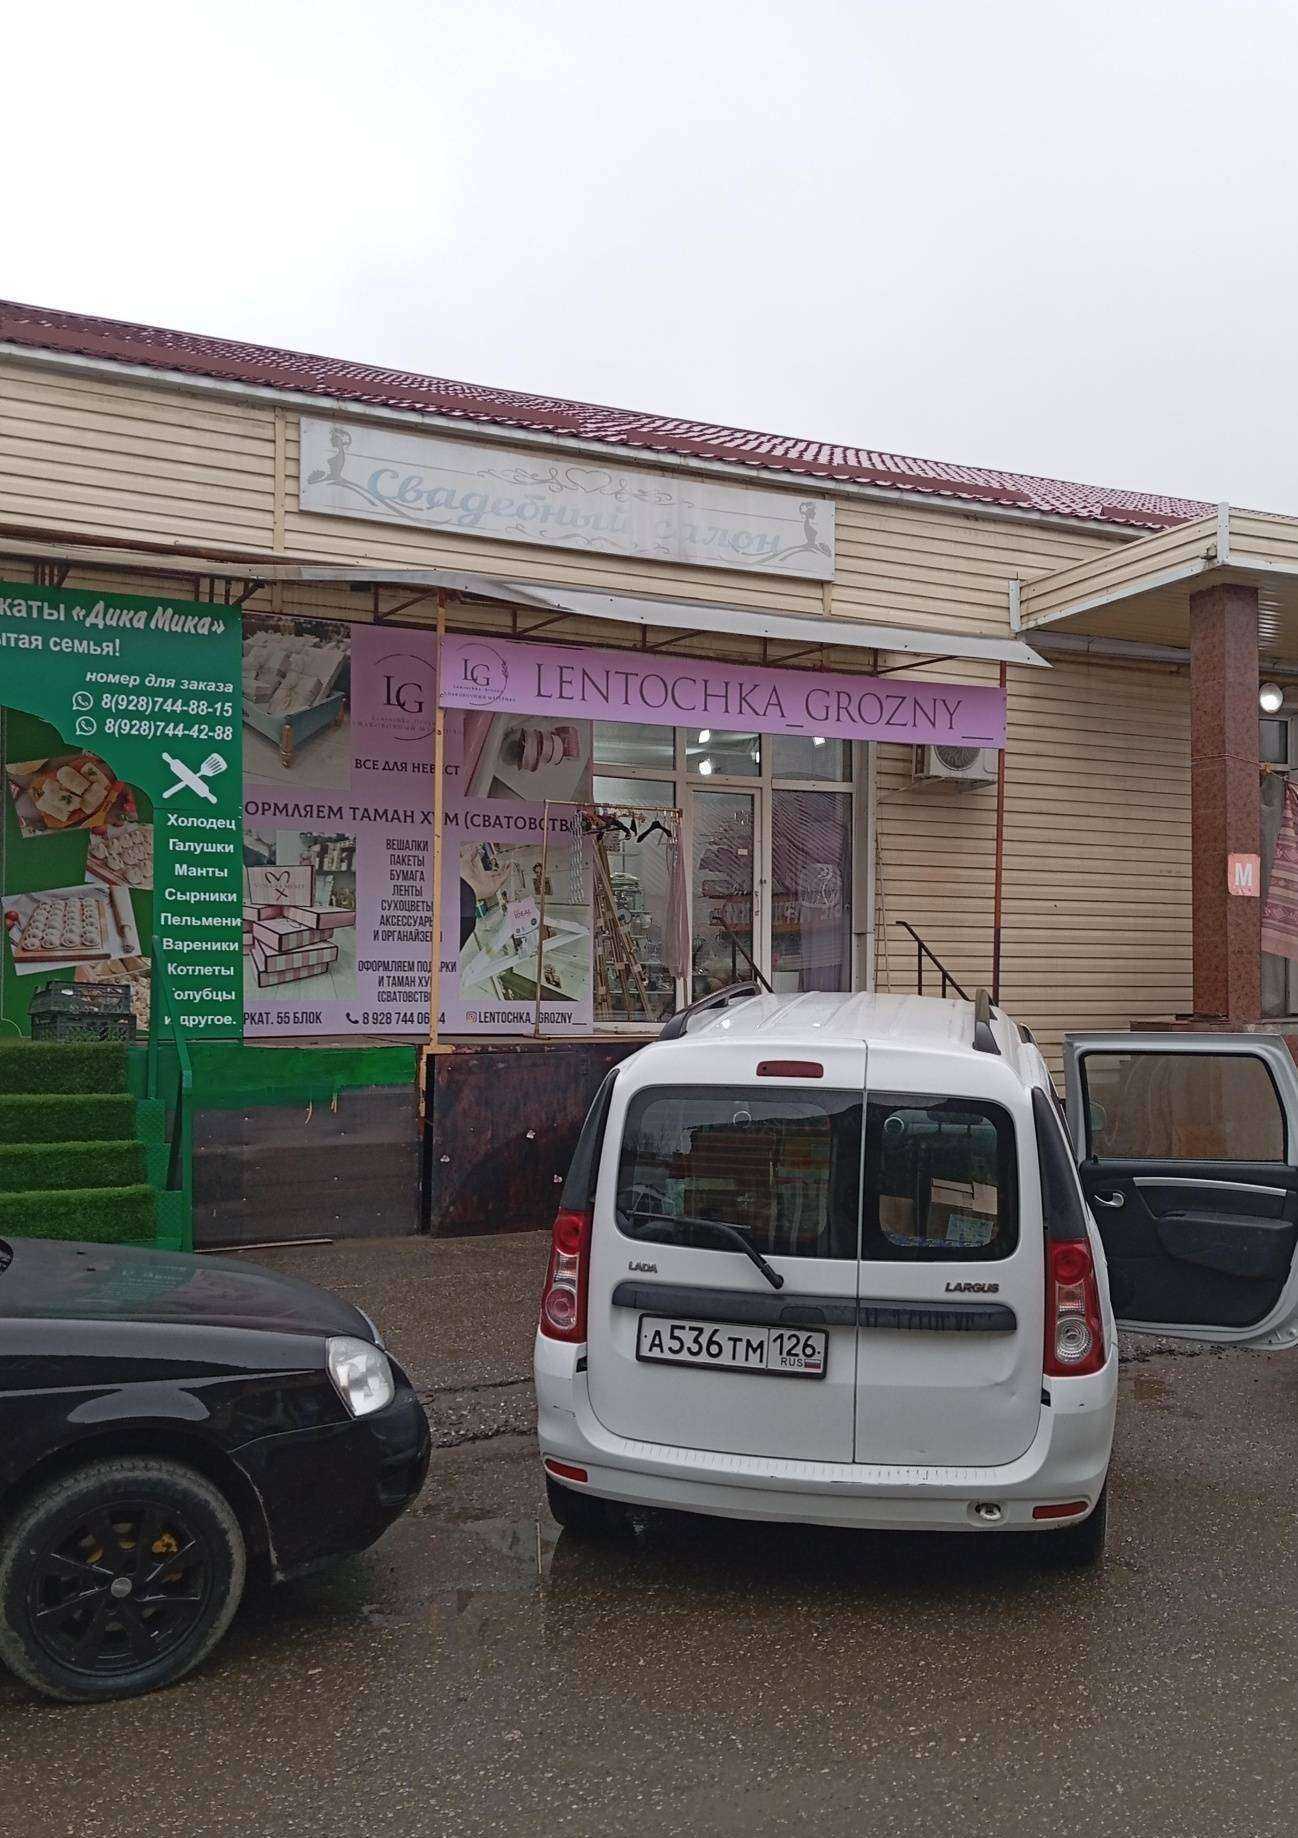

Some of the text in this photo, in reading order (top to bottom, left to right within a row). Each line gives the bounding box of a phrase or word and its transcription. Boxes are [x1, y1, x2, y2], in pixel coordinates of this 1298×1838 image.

[366, 467, 630, 534] Свадебный
[72, 600, 148, 630] «Дика
[150, 606, 227, 635] Мика»
[49, 637, 121, 656] семья!
[463, 657, 490, 687] LG
[85, 671, 234, 693] номер для заказа
[384, 675, 424, 714] LG
[101, 693, 233, 717] 8(928)744-88-15
[104, 718, 234, 741] 8(928)744-42-88
[354, 759, 460, 776] ВСЕ ДЛЯ НЕВСТ
[167, 813, 236, 830] Холодец
[348, 807, 415, 824] ТАМАН
[419, 810, 460, 828] ХМ
[463, 811, 574, 832] (СВАТОВСТВ
[169, 838, 235, 855] Галушки
[386, 838, 429, 852] ВЕШАЛКИ
[389, 853, 425, 867] ПАКЕТЫ
[174, 863, 229, 878] Манты
[389, 869, 426, 883] БУМАГА
[1234, 862, 1253, 886] M
[165, 888, 238, 904] Сырники
[391, 884, 423, 897] ЛЕНТЫ
[381, 900, 434, 915] СУХОЦВЕТЫ
[161, 912, 243, 928] Пельмени
[373, 929, 443, 944] И ОРГАНАЙЗЕ
[163, 938, 239, 955] Вареники
[168, 963, 235, 977] Котлеты
[358, 960, 457, 974] ОФОРМЛЯЕМ ПОДРКИ
[378, 976, 433, 988] И ТАМАН ХУ
[172, 987, 236, 1002] олубцы
[377, 991, 432, 1005] (СВАТОВСТВ
[276, 1012, 290, 1025] 55
[293, 1011, 322, 1025] БЛОК
[362, 1012, 370, 1025] 8
[372, 1012, 393, 1026] 928
[394, 1012, 414, 1025] 744
[629, 1261, 658, 1273] LADA
[944, 1281, 1001, 1294] LARGUS
[648, 1324, 818, 1364] А536ТМ 126
[780, 1357, 804, 1368] RUS
